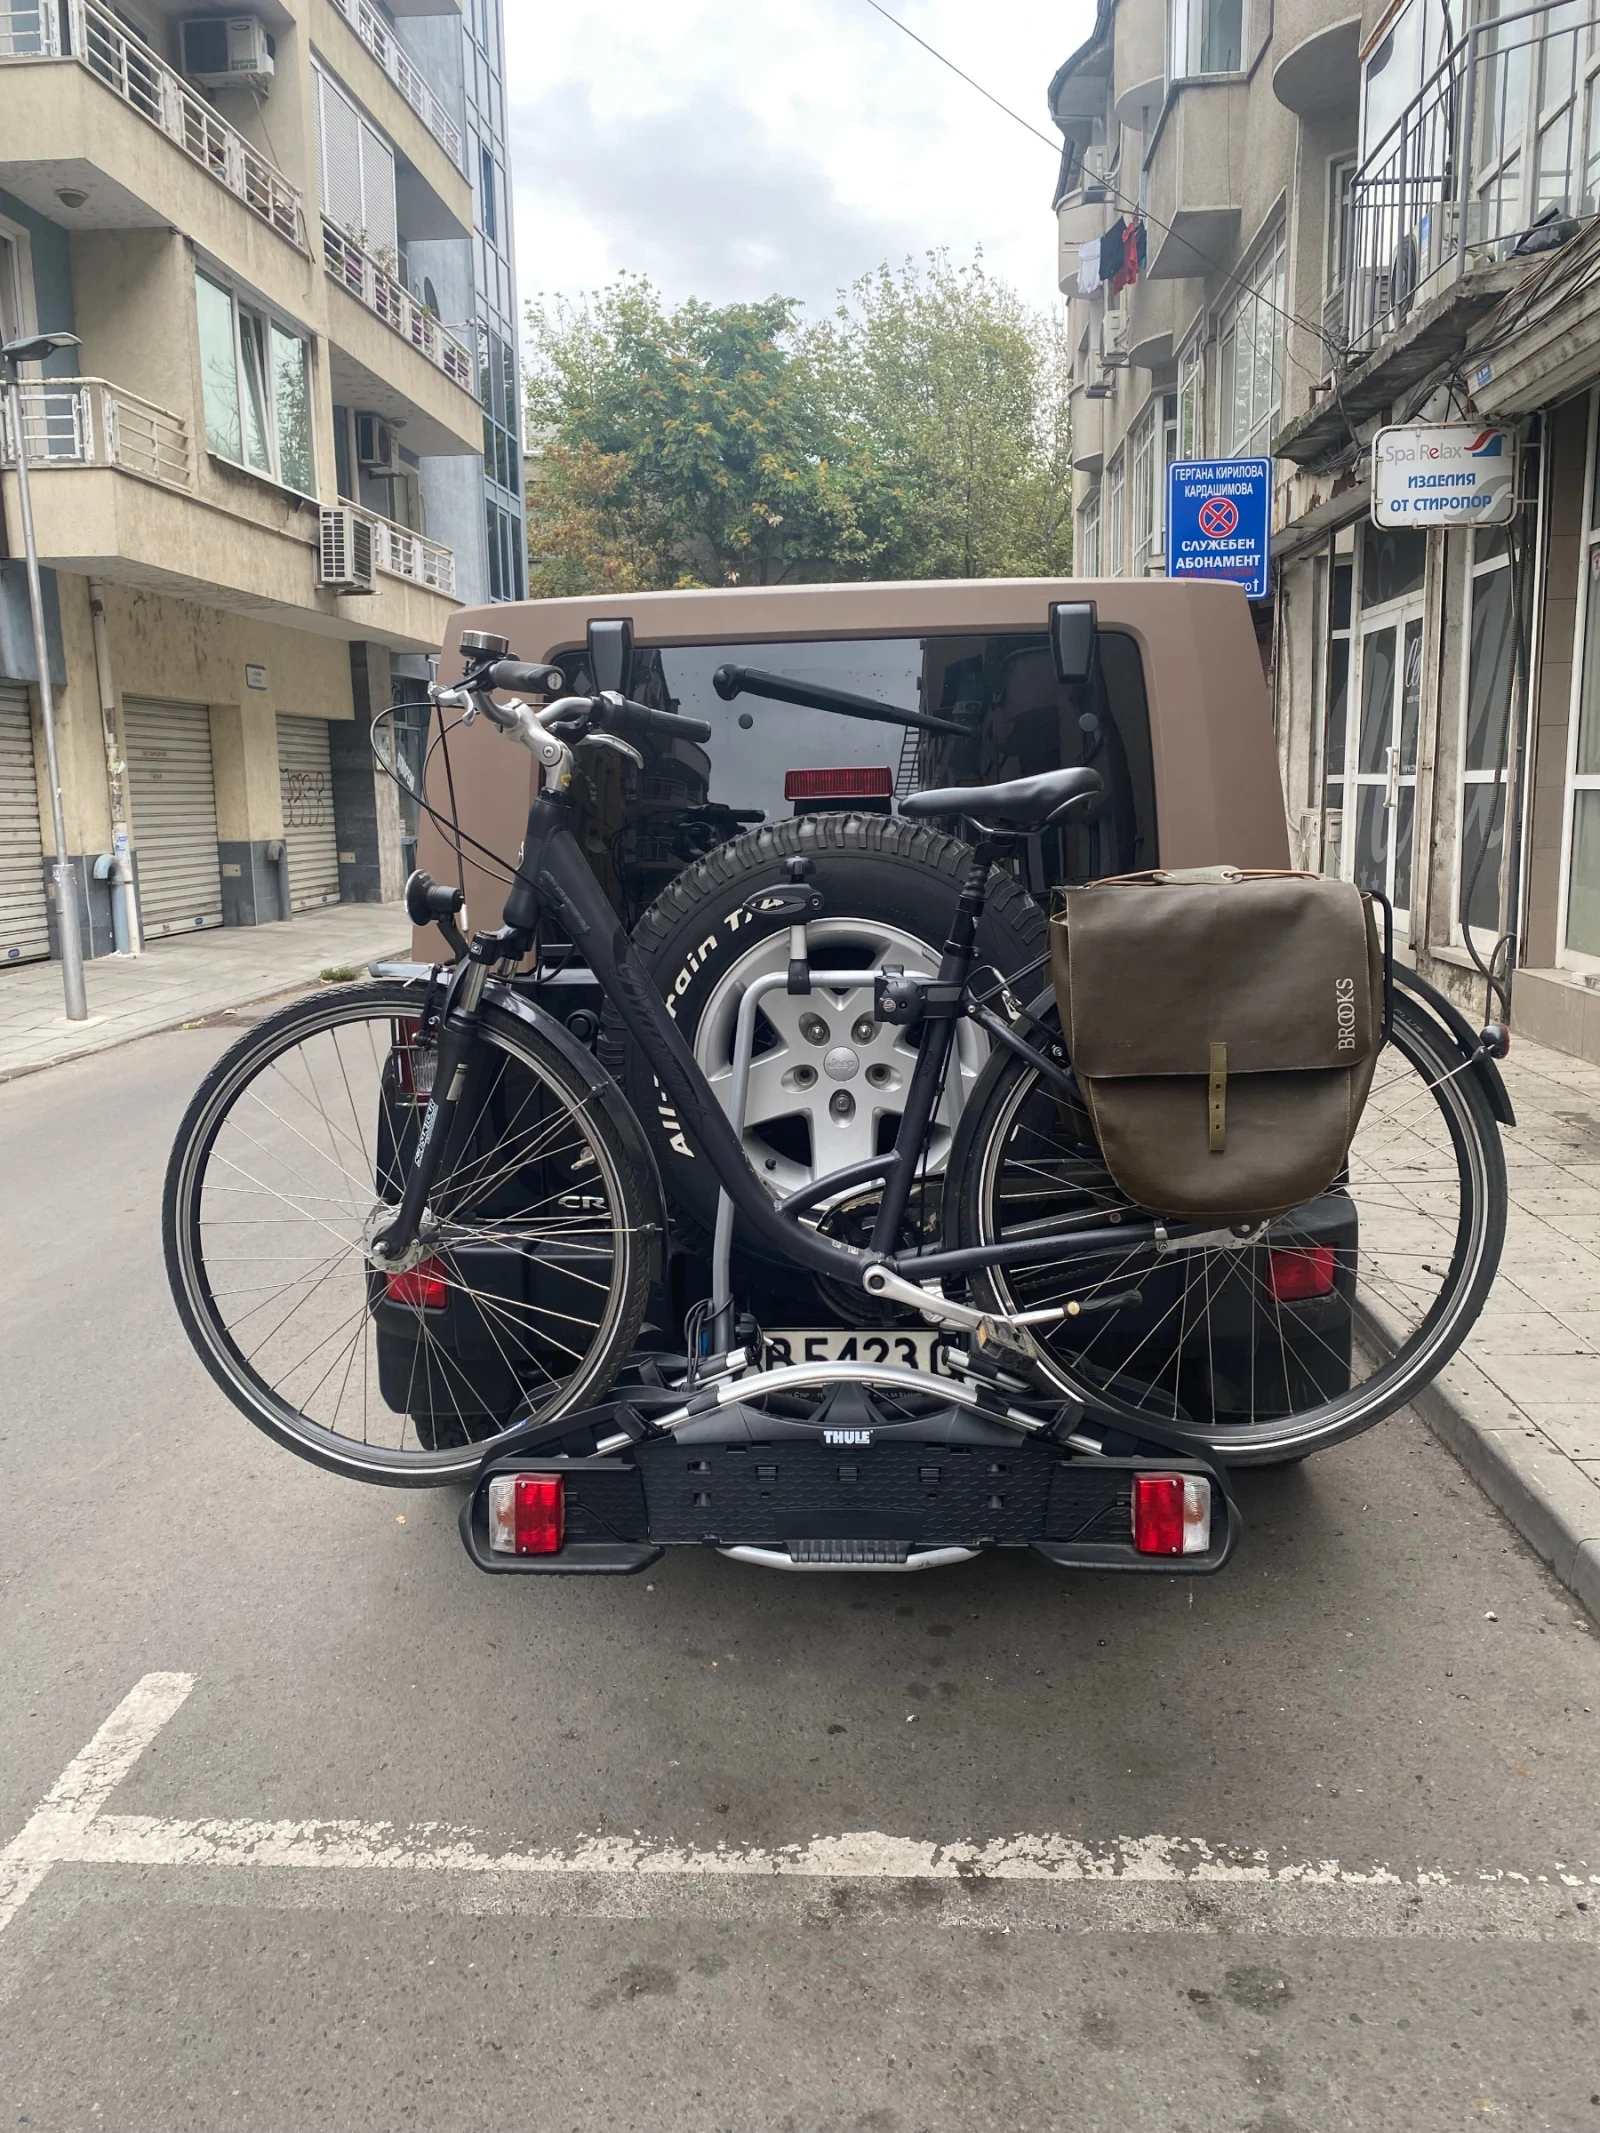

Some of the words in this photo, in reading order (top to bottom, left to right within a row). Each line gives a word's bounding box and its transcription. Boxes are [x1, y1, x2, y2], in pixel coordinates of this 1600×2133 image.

[1385, 445, 1415, 466] Spa
[1420, 442, 1462, 460] Relax
[1175, 467, 1214, 481] ГЕРГАНА
[1215, 465, 1264, 479] КИРИЛОВА
[1408, 473, 1476, 489] ИЗДЕЛИЯ
[1184, 482, 1254, 499] КАРДАШИМОВА
[1390, 499, 1410, 512] ОТ
[1413, 495, 1492, 511] СТИРОПОР
[1181, 538, 1255, 552] СЛУЖЕБЕН
[1176, 554, 1261, 569] АБОНАМЕНТ
[1335, 977, 1356, 1051] BROOKS
[827, 1057, 855, 1071] Jeep
[823, 1430, 870, 1444] THULE
